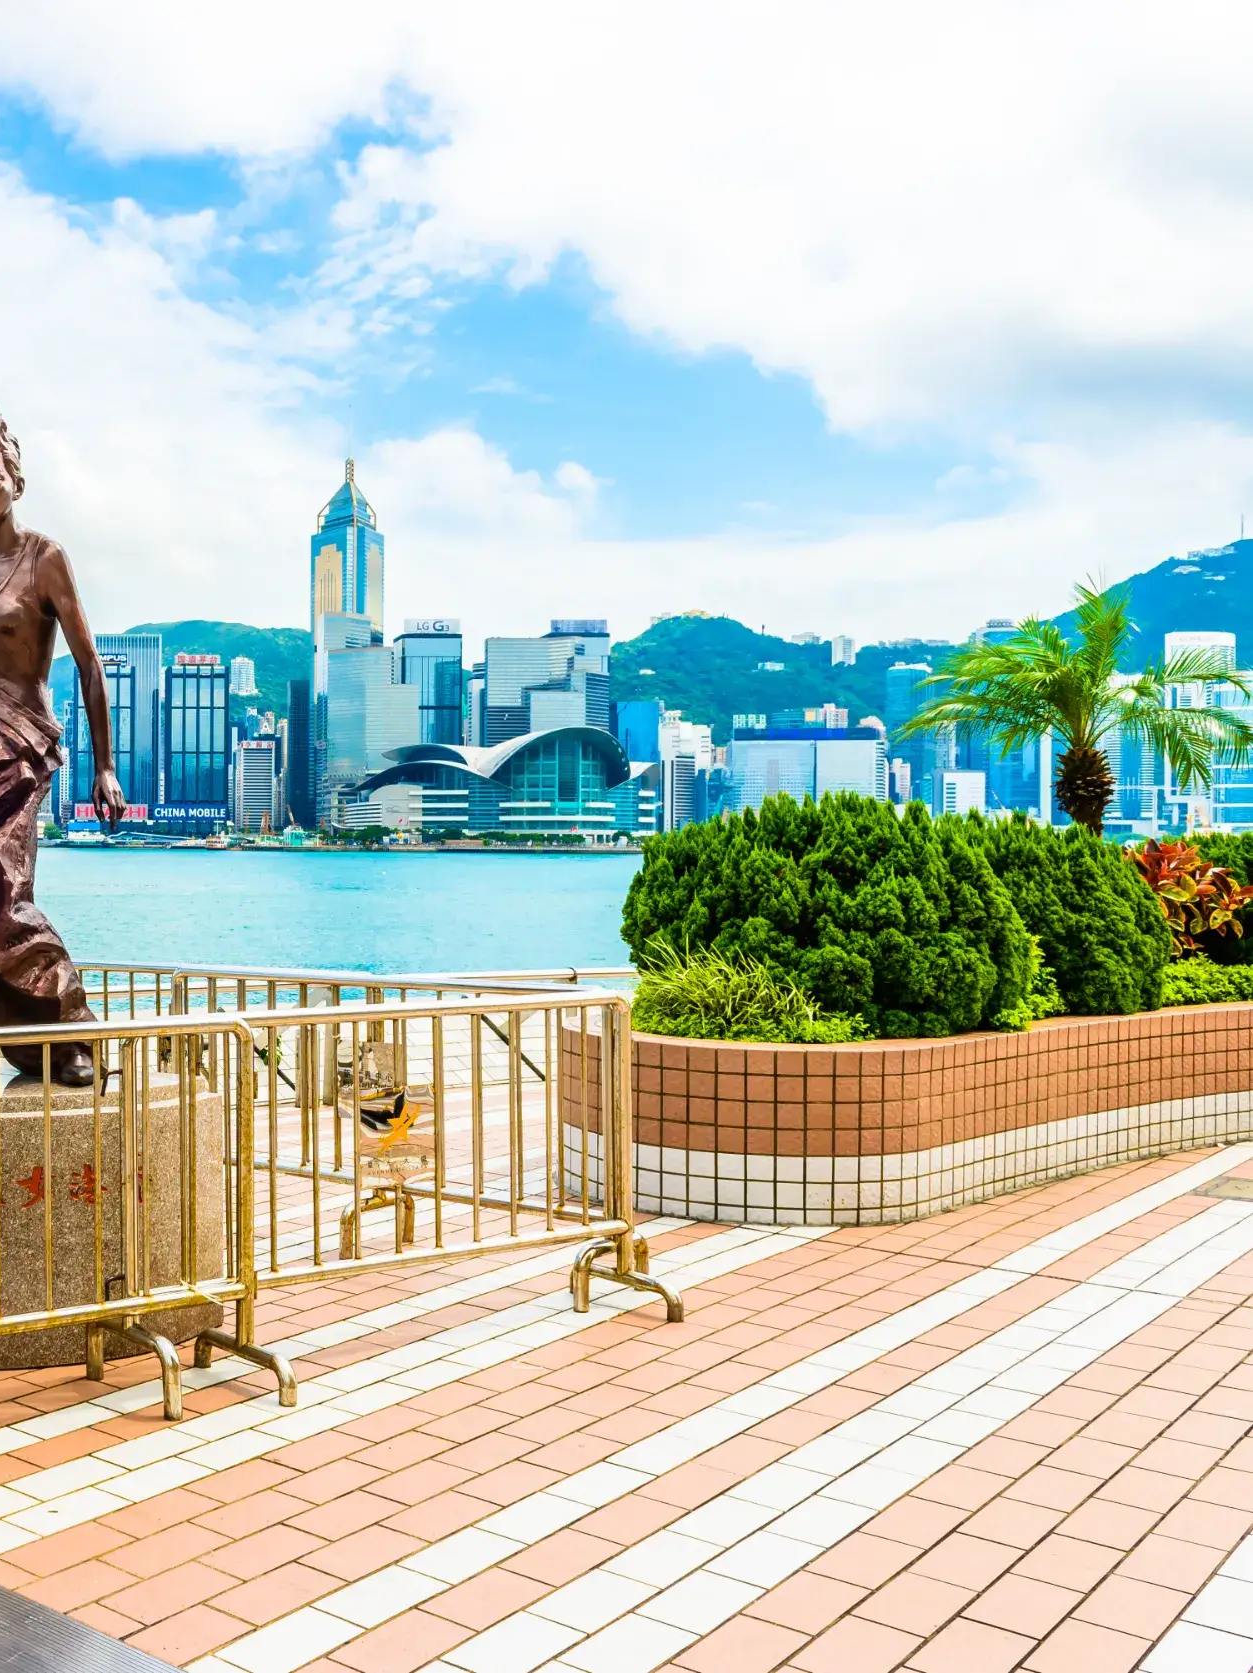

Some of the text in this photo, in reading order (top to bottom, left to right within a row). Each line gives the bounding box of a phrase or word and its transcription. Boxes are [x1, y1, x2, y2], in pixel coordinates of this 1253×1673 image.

[416, 620, 450, 632] LG G3
[100, 654, 127, 662] MPUS
[76, 806, 147, 818] HIHI
[154, 807, 226, 818] CHINA MOBILE
